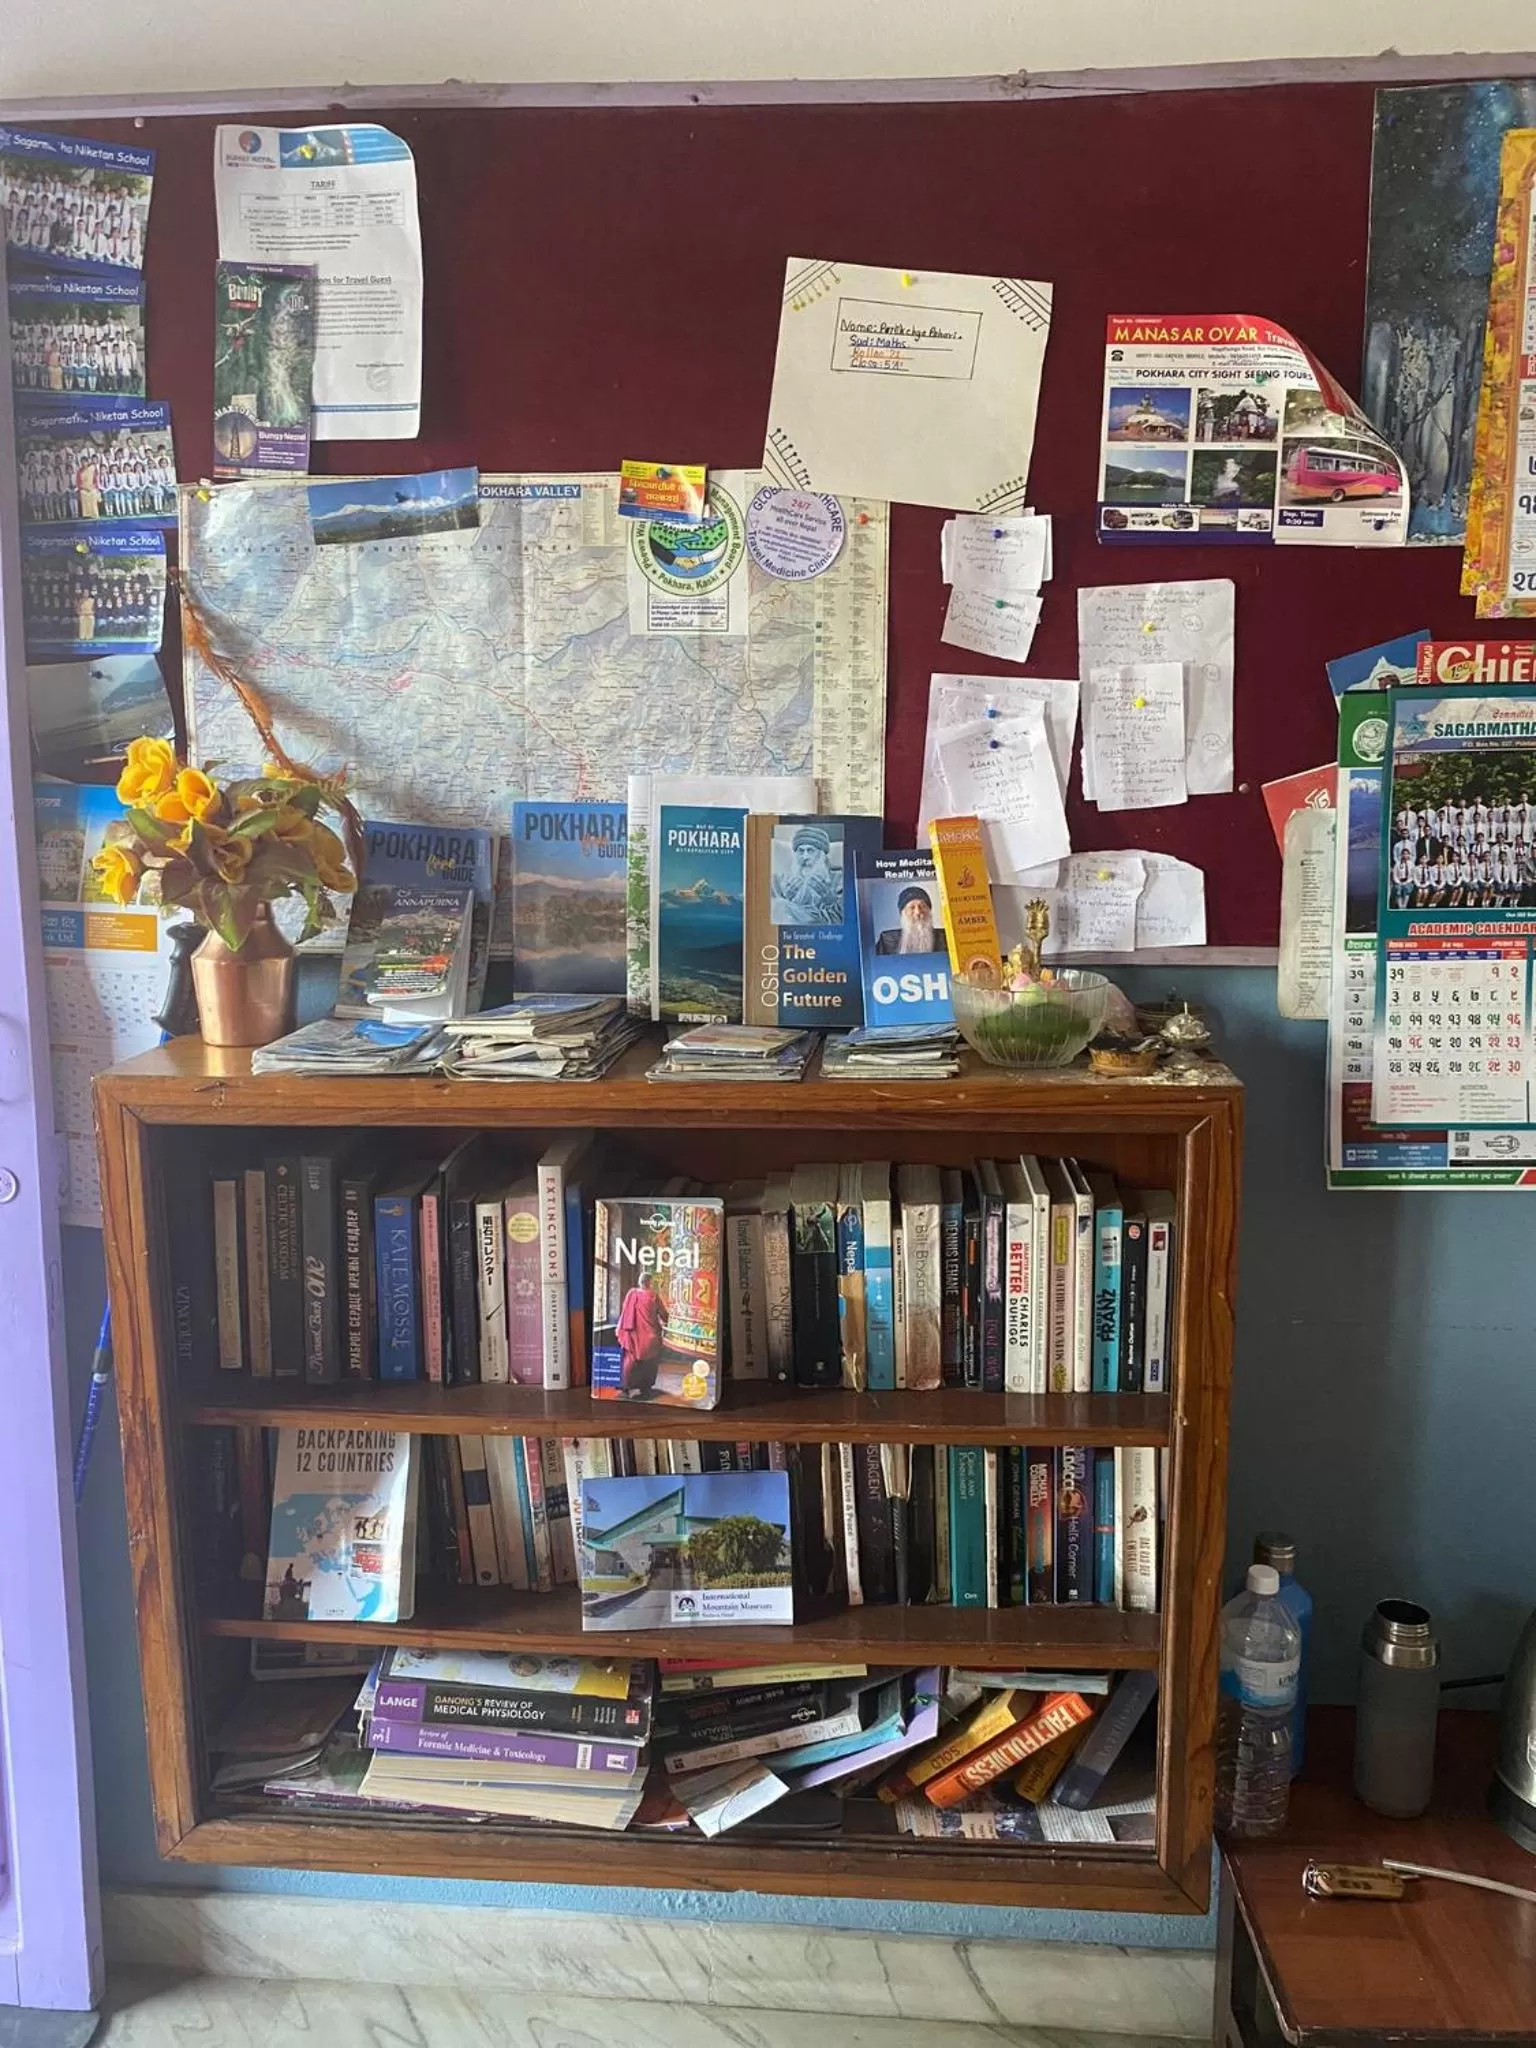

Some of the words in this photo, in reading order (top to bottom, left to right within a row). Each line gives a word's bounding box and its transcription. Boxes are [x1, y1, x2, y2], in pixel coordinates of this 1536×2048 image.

[74, 144, 114, 160] Niketan
[117, 150, 150, 165] School
[311, 180, 335, 189] TARIFF
[64, 283, 103, 295] Niketan
[105, 285, 139, 297] School
[333, 276, 343, 284] for
[370, 275, 391, 284] Guest
[840, 318, 877, 333] Name:
[1115, 327, 1204, 342] MANASAR
[1209, 327, 1258, 342] OVAR
[876, 336, 907, 348] Maths
[1136, 370, 1185, 378] POKHARA
[1188, 370, 1209, 378] CITY
[1211, 371, 1242, 379] SIGHT
[1244, 371, 1280, 379] SEEING
[1284, 371, 1313, 381] TOURS
[90, 411, 128, 422] Niketan
[131, 407, 164, 419] School
[477, 486, 532, 497] POKHARA
[535, 485, 580, 498] VALLEY
[711, 487, 741, 540] Management
[89, 536, 127, 546] Niketan
[130, 534, 161, 546] School
[726, 541, 741, 570] Board
[748, 530, 765, 561] Travel
[764, 558, 806, 578] Medicine
[808, 551, 832, 574] Clinic
[658, 573, 695, 591] Pokhara,
[1434, 722, 1536, 737] SAGARMATHA
[525, 812, 628, 842] POKHARA
[367, 830, 476, 865] POKHARA
[668, 830, 740, 849] POKHARA
[876, 859, 896, 868] How
[900, 858, 934, 868] Medita
[884, 870, 914, 880] Really
[394, 897, 460, 908] ANNAPURNA
[957, 915, 988, 926] AMBER
[1408, 922, 1474, 936] ACADEMIC
[1475, 922, 1536, 935] CALENDAR
[783, 945, 816, 960] The
[761, 944, 779, 1008] OSHO
[783, 968, 847, 984] Golden
[872, 972, 949, 1005] OSH
[783, 992, 842, 1008] Future
[277, 1184, 288, 1226] CELTIC
[346, 1210, 360, 1253] СЕНДЛЕР
[546, 1177, 558, 1280] EXTINCTIONS
[737, 1219, 752, 1246] David
[914, 1224, 929, 1246] Bill
[946, 1220, 958, 1258] DENNIS
[277, 1228, 288, 1280] WISDOM
[391, 1229, 408, 1278] KATE
[614, 1238, 700, 1272] Nepal
[846, 1240, 858, 1274] Nepa
[346, 1256, 360, 1289] ИРЕНЫ
[914, 1249, 930, 1299] Bryson
[946, 1259, 959, 1296] LEHANE
[1009, 1242, 1023, 1294] BETTER
[346, 1292, 362, 1328] СЕРДЦЕ
[392, 1282, 410, 1350] MOSSE
[1102, 1289, 1116, 1342] FRANZ
[1009, 1298, 1018, 1346] DUHIGG
[1020, 1296, 1029, 1347] CHARLES
[346, 1331, 362, 1369] ХРАБРОЕ
[296, 1430, 396, 1450] BACKPACKING
[296, 1453, 312, 1472] 12
[318, 1452, 394, 1473] COUNTRIES
[1068, 1516, 1079, 1542] Hell's
[1067, 1543, 1079, 1578] Corner
[701, 1591, 751, 1600] International
[702, 1602, 739, 1612] Mountain
[740, 1602, 772, 1612] Museum
[379, 1696, 418, 1708] LANGE
[434, 1696, 482, 1707] GANONG'S
[484, 1698, 518, 1710] REVIEW
[520, 1701, 533, 1710] OF
[434, 1704, 478, 1716] MEDICAL
[480, 1708, 546, 1720] PHYSIOLOGY
[419, 1728, 440, 1737] Review
[442, 1731, 449, 1739] of
[418, 1738, 452, 1750] Forensic
[454, 1741, 492, 1756] Medicine
[494, 1746, 500, 1756] &
[503, 1746, 547, 1763] Toxicology
[965, 1704, 1078, 1786] FACTFULNESS
